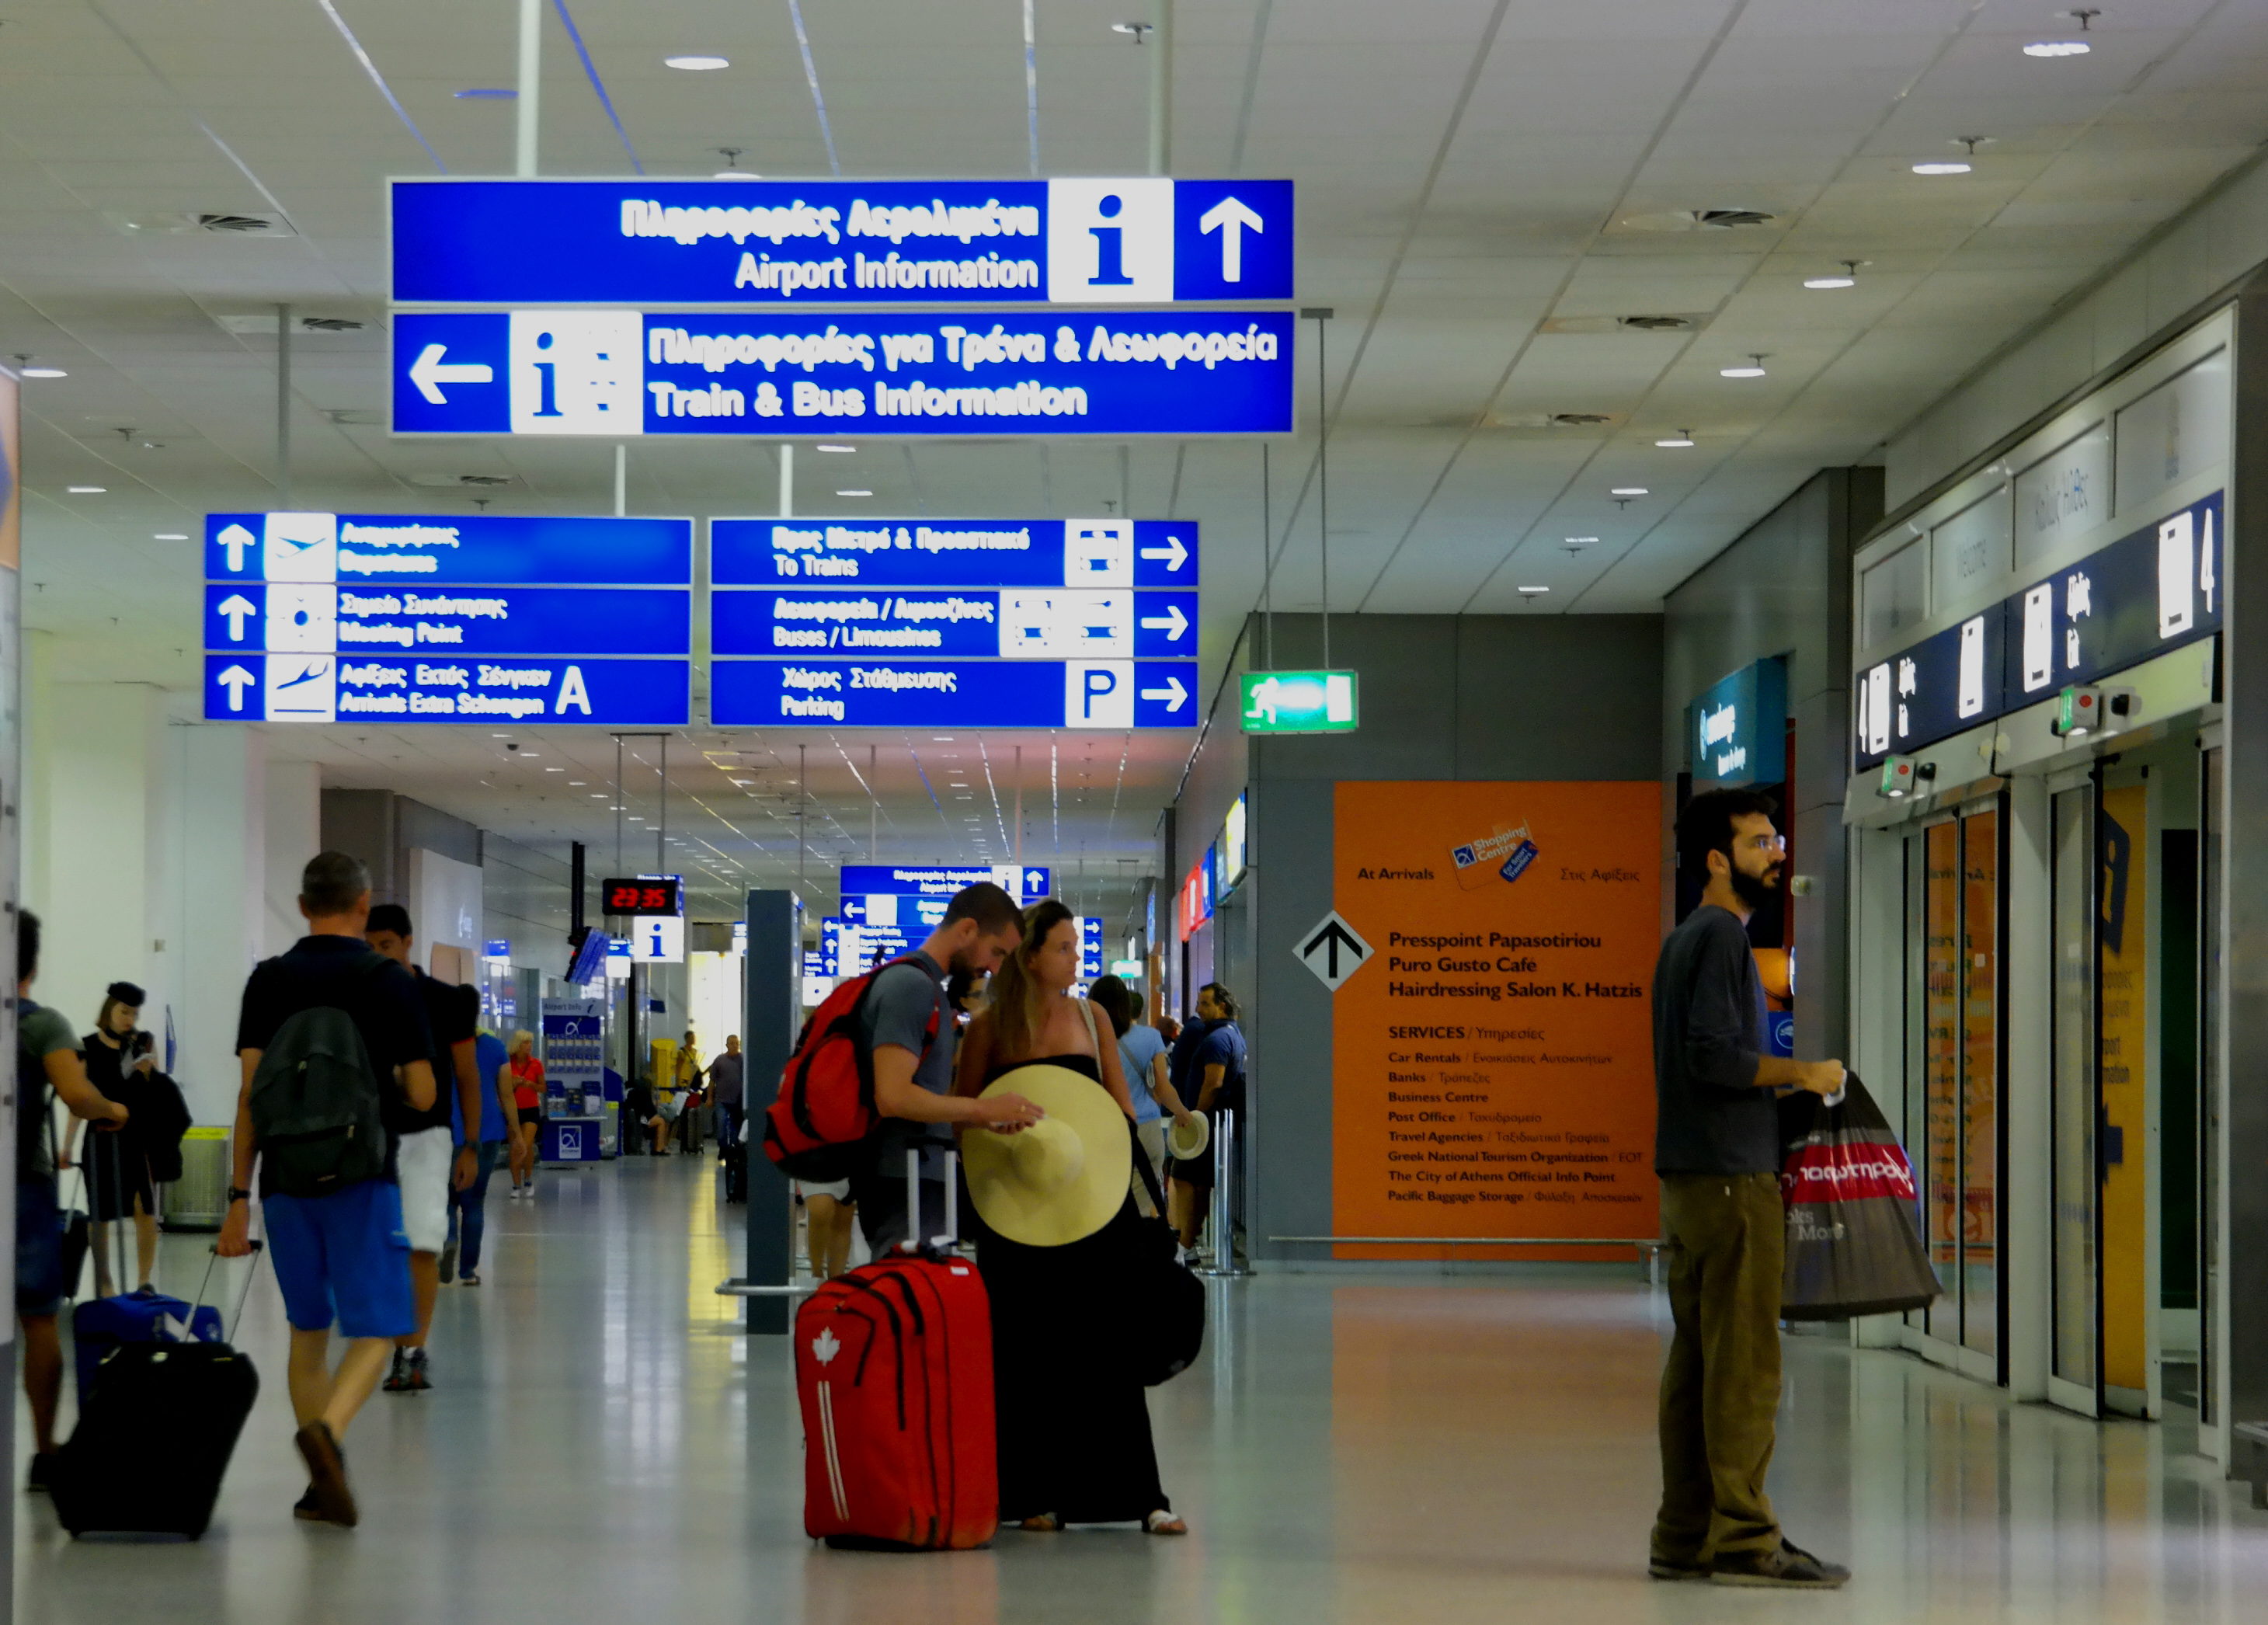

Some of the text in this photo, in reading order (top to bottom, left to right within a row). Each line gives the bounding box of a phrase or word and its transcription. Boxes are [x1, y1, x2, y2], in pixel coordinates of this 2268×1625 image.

[621, 199, 1038, 245] Πληροφορίες Αερολιμένα
[736, 252, 1038, 297] Airport Information
[649, 324, 1277, 372] Πληροφορίες για Τρένα & Λεωφορεία
[648, 381, 1087, 417] Train & Bus Information
[895, 528, 912, 549] &
[774, 555, 858, 576] To Trains
[881, 598, 892, 621] /
[416, 623, 463, 643] Point
[774, 626, 941, 648] Buses / Limousines
[416, 665, 468, 688] Εκτός
[783, 668, 956, 692] Χώρος Στάθμευσης
[555, 666, 592, 715] A
[1084, 670, 1116, 719] P
[781, 696, 844, 720] Parking
[1473, 826, 1526, 851] Shopping
[1478, 842, 1518, 861] Centre
[1358, 868, 1434, 879] At Arrivals
[1560, 868, 1640, 883] Στις Αφίξεις
[1390, 932, 1601, 952] Presspoint Papasotiriou
[1390, 957, 1536, 972] Puro Gusto Café
[1390, 982, 1642, 1000] Hairdressing Salon K. Hatzis
[1390, 1027, 1465, 1039] SERVICES
[1476, 1026, 1545, 1042] Υπηρεσίες
[1389, 1053, 1411, 1062] Car
[1415, 1053, 1460, 1063] Rentals
[1389, 1072, 1425, 1082] Banks
[1389, 1092, 1488, 1102] Business Centre
[1389, 1112, 1414, 1122] Post
[1419, 1112, 1456, 1122] Office
[1389, 1131, 1425, 1141] Travel
[1428, 1132, 1483, 1144] Agencies
[1388, 1151, 1424, 1161] Greek
[1428, 1151, 1478, 1161] National
[1481, 1152, 1527, 1161] Tourism
[1531, 1152, 1608, 1164] Organization
[1389, 1171, 1615, 1184] The City of Athens Official Info Point
[1389, 1191, 1423, 1201] Pacific
[1428, 1191, 1475, 1204] Baggage
[1479, 1192, 1523, 1204] Storage
